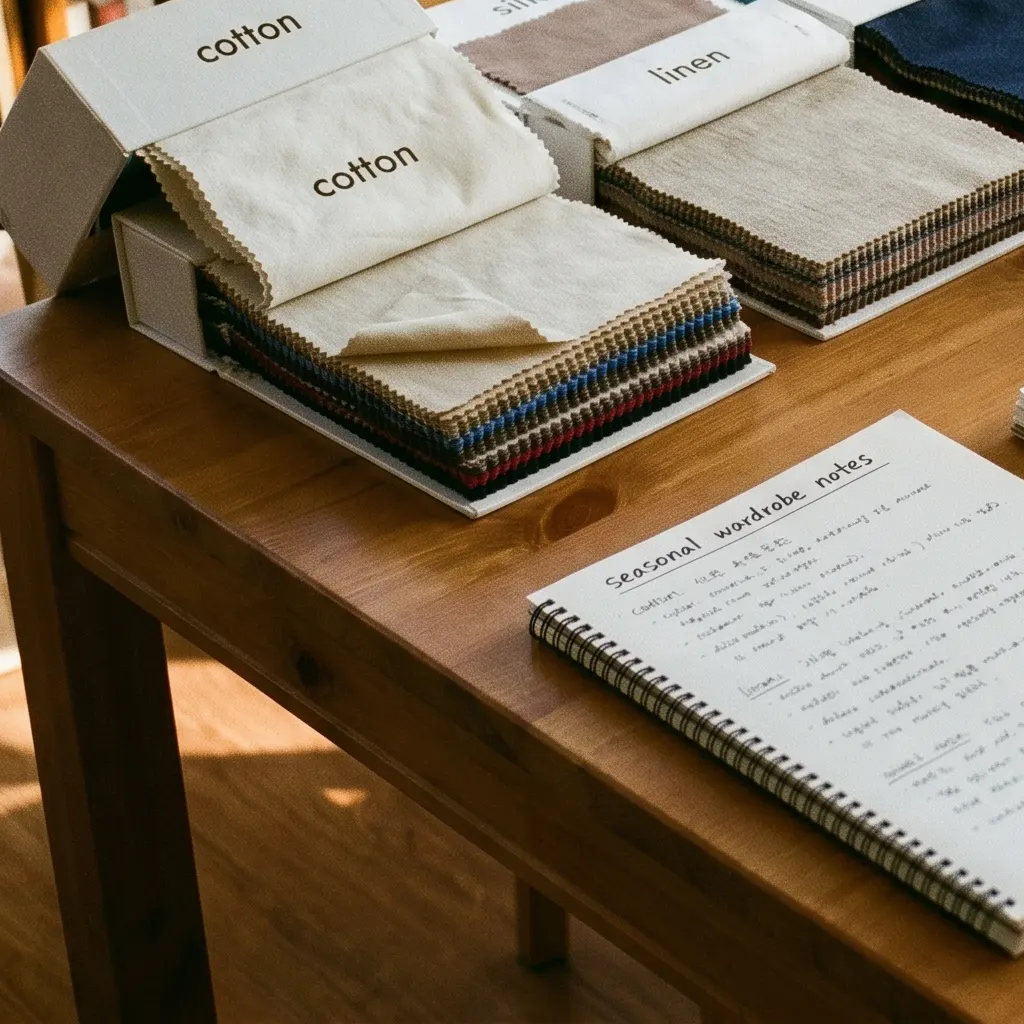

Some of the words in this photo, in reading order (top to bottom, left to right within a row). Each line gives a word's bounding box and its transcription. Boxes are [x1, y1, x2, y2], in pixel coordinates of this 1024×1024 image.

[196, 14, 303, 63] cotton
[647, 50, 731, 85] linen
[312, 146, 420, 197] cotton
[713, 487, 807, 540] wardrobe
[814, 452, 874, 489] notes
